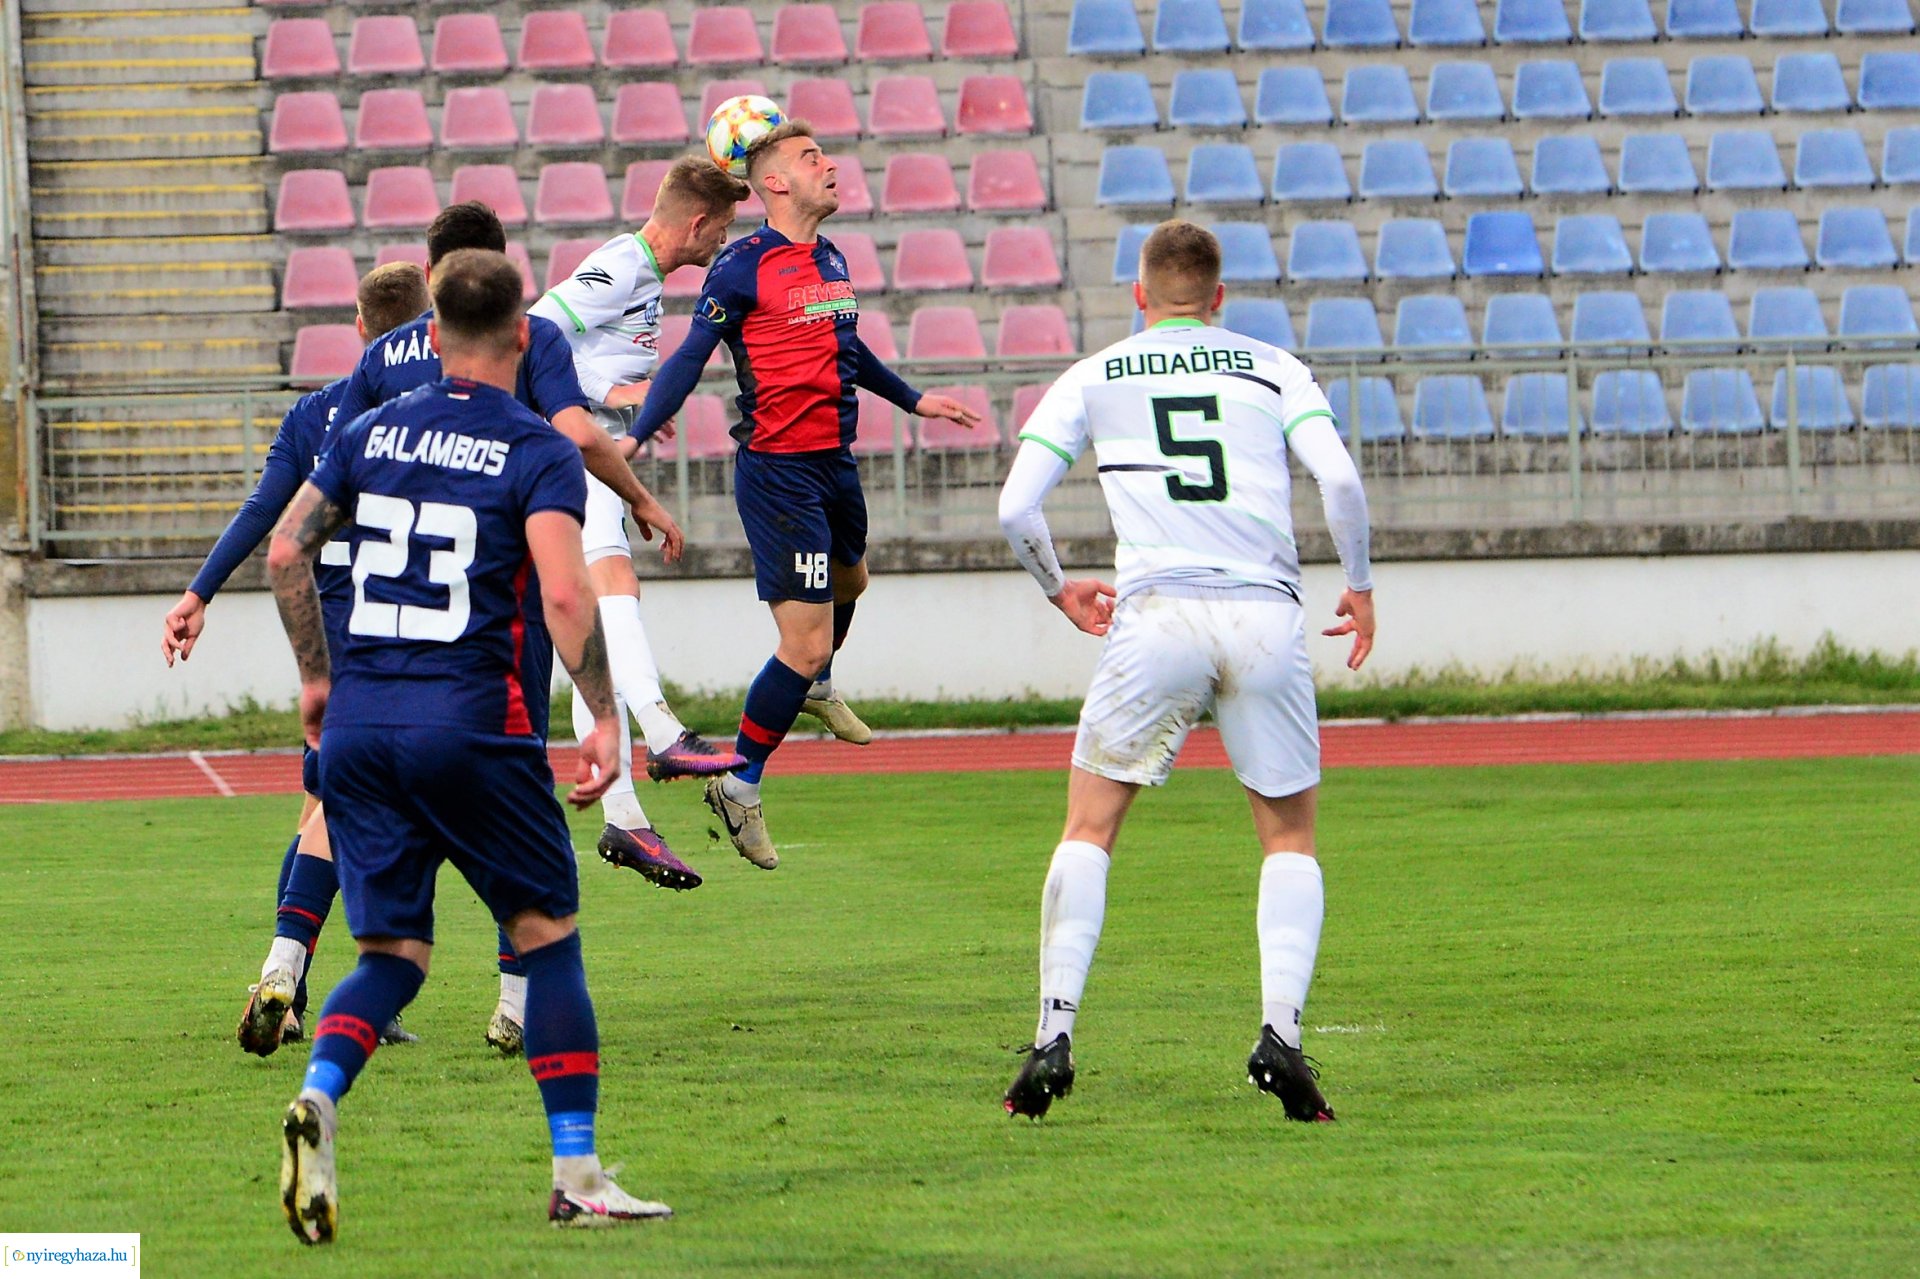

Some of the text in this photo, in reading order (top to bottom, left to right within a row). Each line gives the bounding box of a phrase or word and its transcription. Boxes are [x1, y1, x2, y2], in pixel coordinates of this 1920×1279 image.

[1105, 345, 1254, 381] BUDAÖRS
[364, 426, 510, 476] GALAMBOS
[1151, 394, 1229, 502] 5
[349, 492, 477, 643] 23
[795, 552, 828, 589] 48
